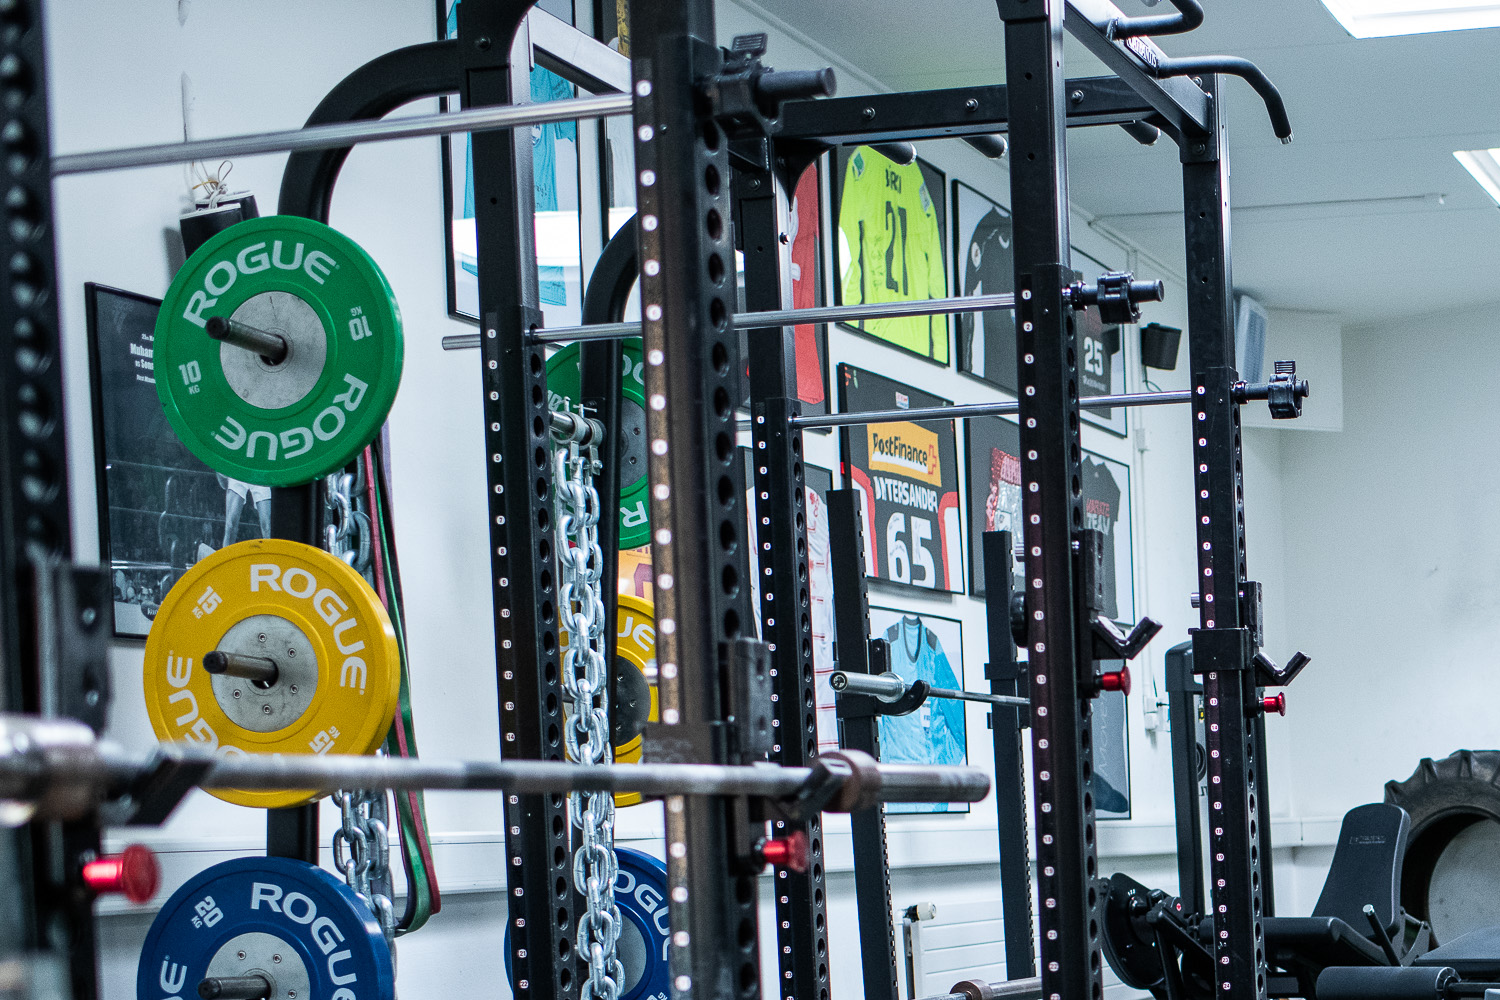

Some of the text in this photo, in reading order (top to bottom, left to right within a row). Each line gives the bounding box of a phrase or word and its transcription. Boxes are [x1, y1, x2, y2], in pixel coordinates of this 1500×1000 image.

[183, 240, 337, 329] ROGUE
[350, 305, 364, 317] KG
[349, 315, 373, 342] 10
[1083, 336, 1104, 377] 25
[178, 360, 203, 387] 10
[188, 384, 201, 395] KG
[213, 372, 369, 461] ROGUE
[873, 433, 928, 467] PostFinance
[887, 512, 936, 589] 65
[191, 606, 204, 620] KG
[196, 585, 223, 615] 15
[250, 563, 368, 689] ROGUE
[328, 726, 341, 739] KG
[191, 916, 203, 930] KG
[194, 896, 224, 928] 20
[657, 992, 668, 1000] KG
